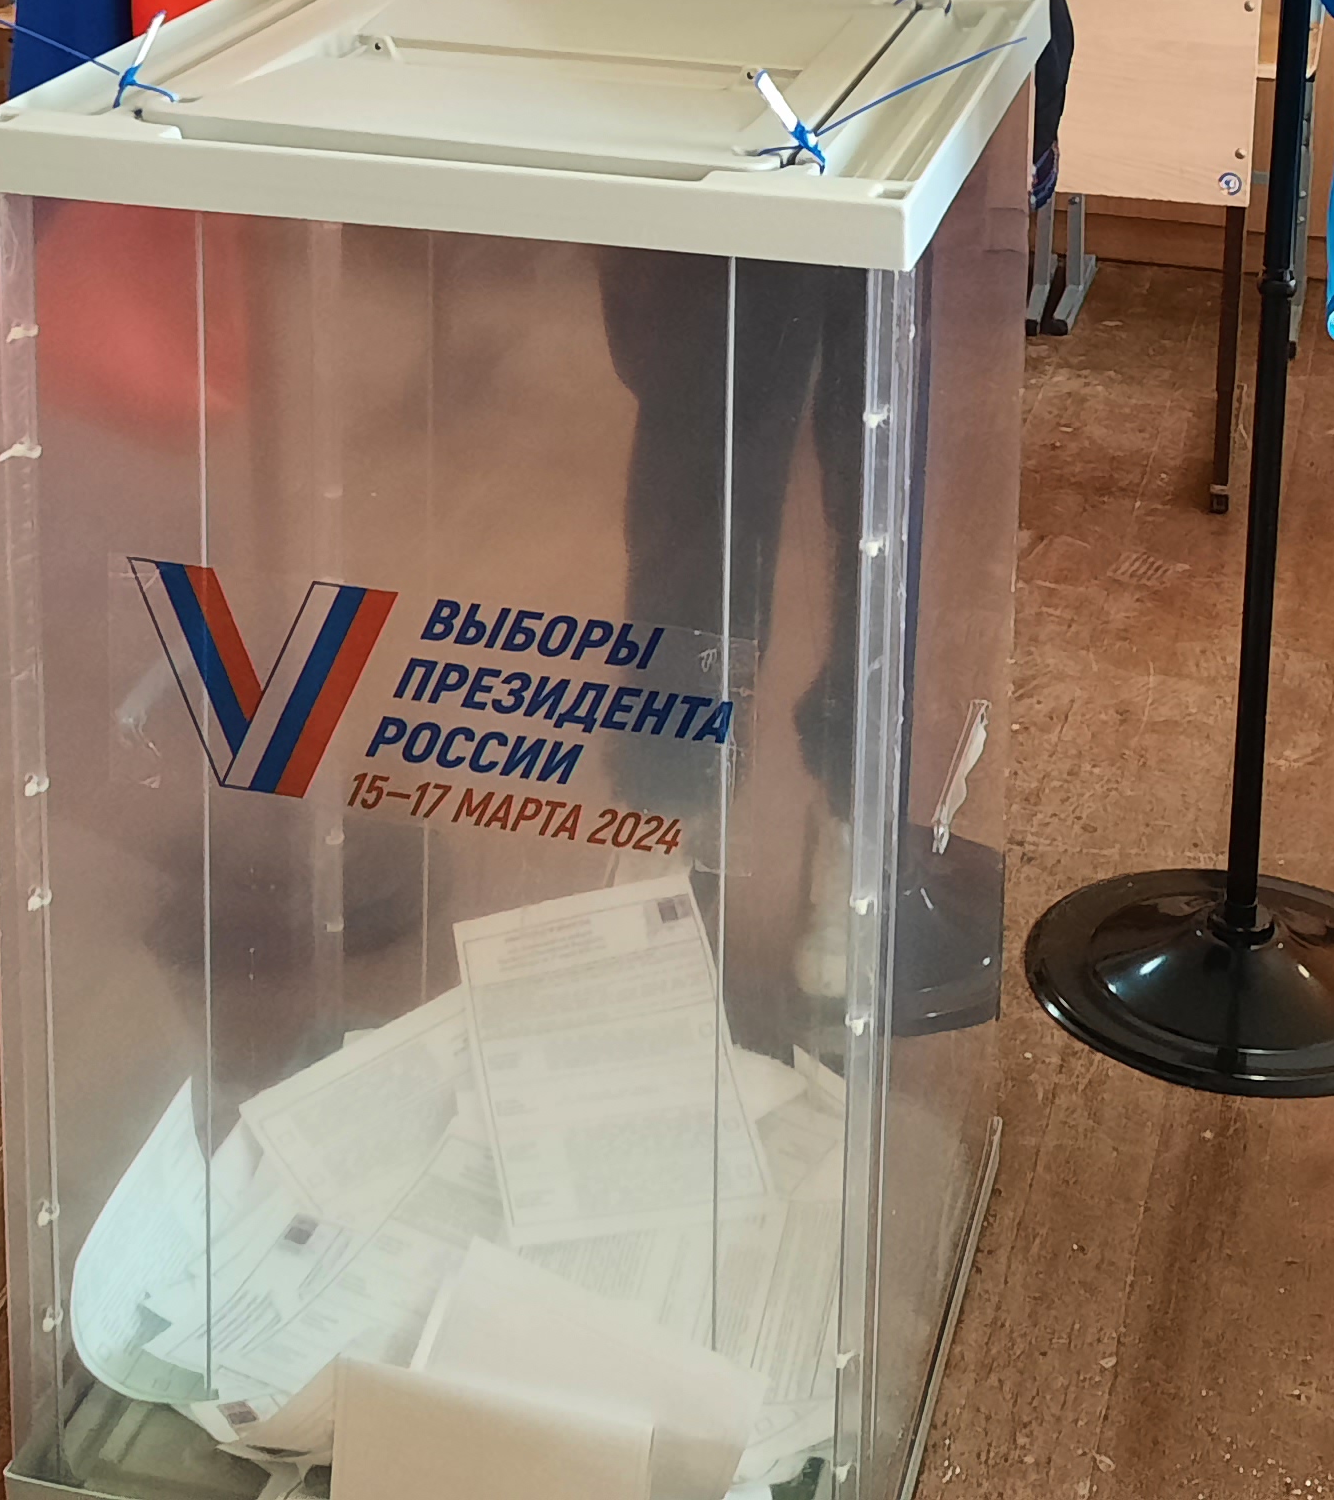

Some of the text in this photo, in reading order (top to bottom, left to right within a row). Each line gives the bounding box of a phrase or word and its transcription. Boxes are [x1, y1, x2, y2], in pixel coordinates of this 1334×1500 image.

[421, 599, 666, 669] ВЫБОРЫ
[394, 658, 734, 744] ПРЕЗИДЕНТА
[366, 717, 583, 785] РОССИИ
[453, 788, 583, 841] МАРТА
[587, 808, 682, 855] 2024
